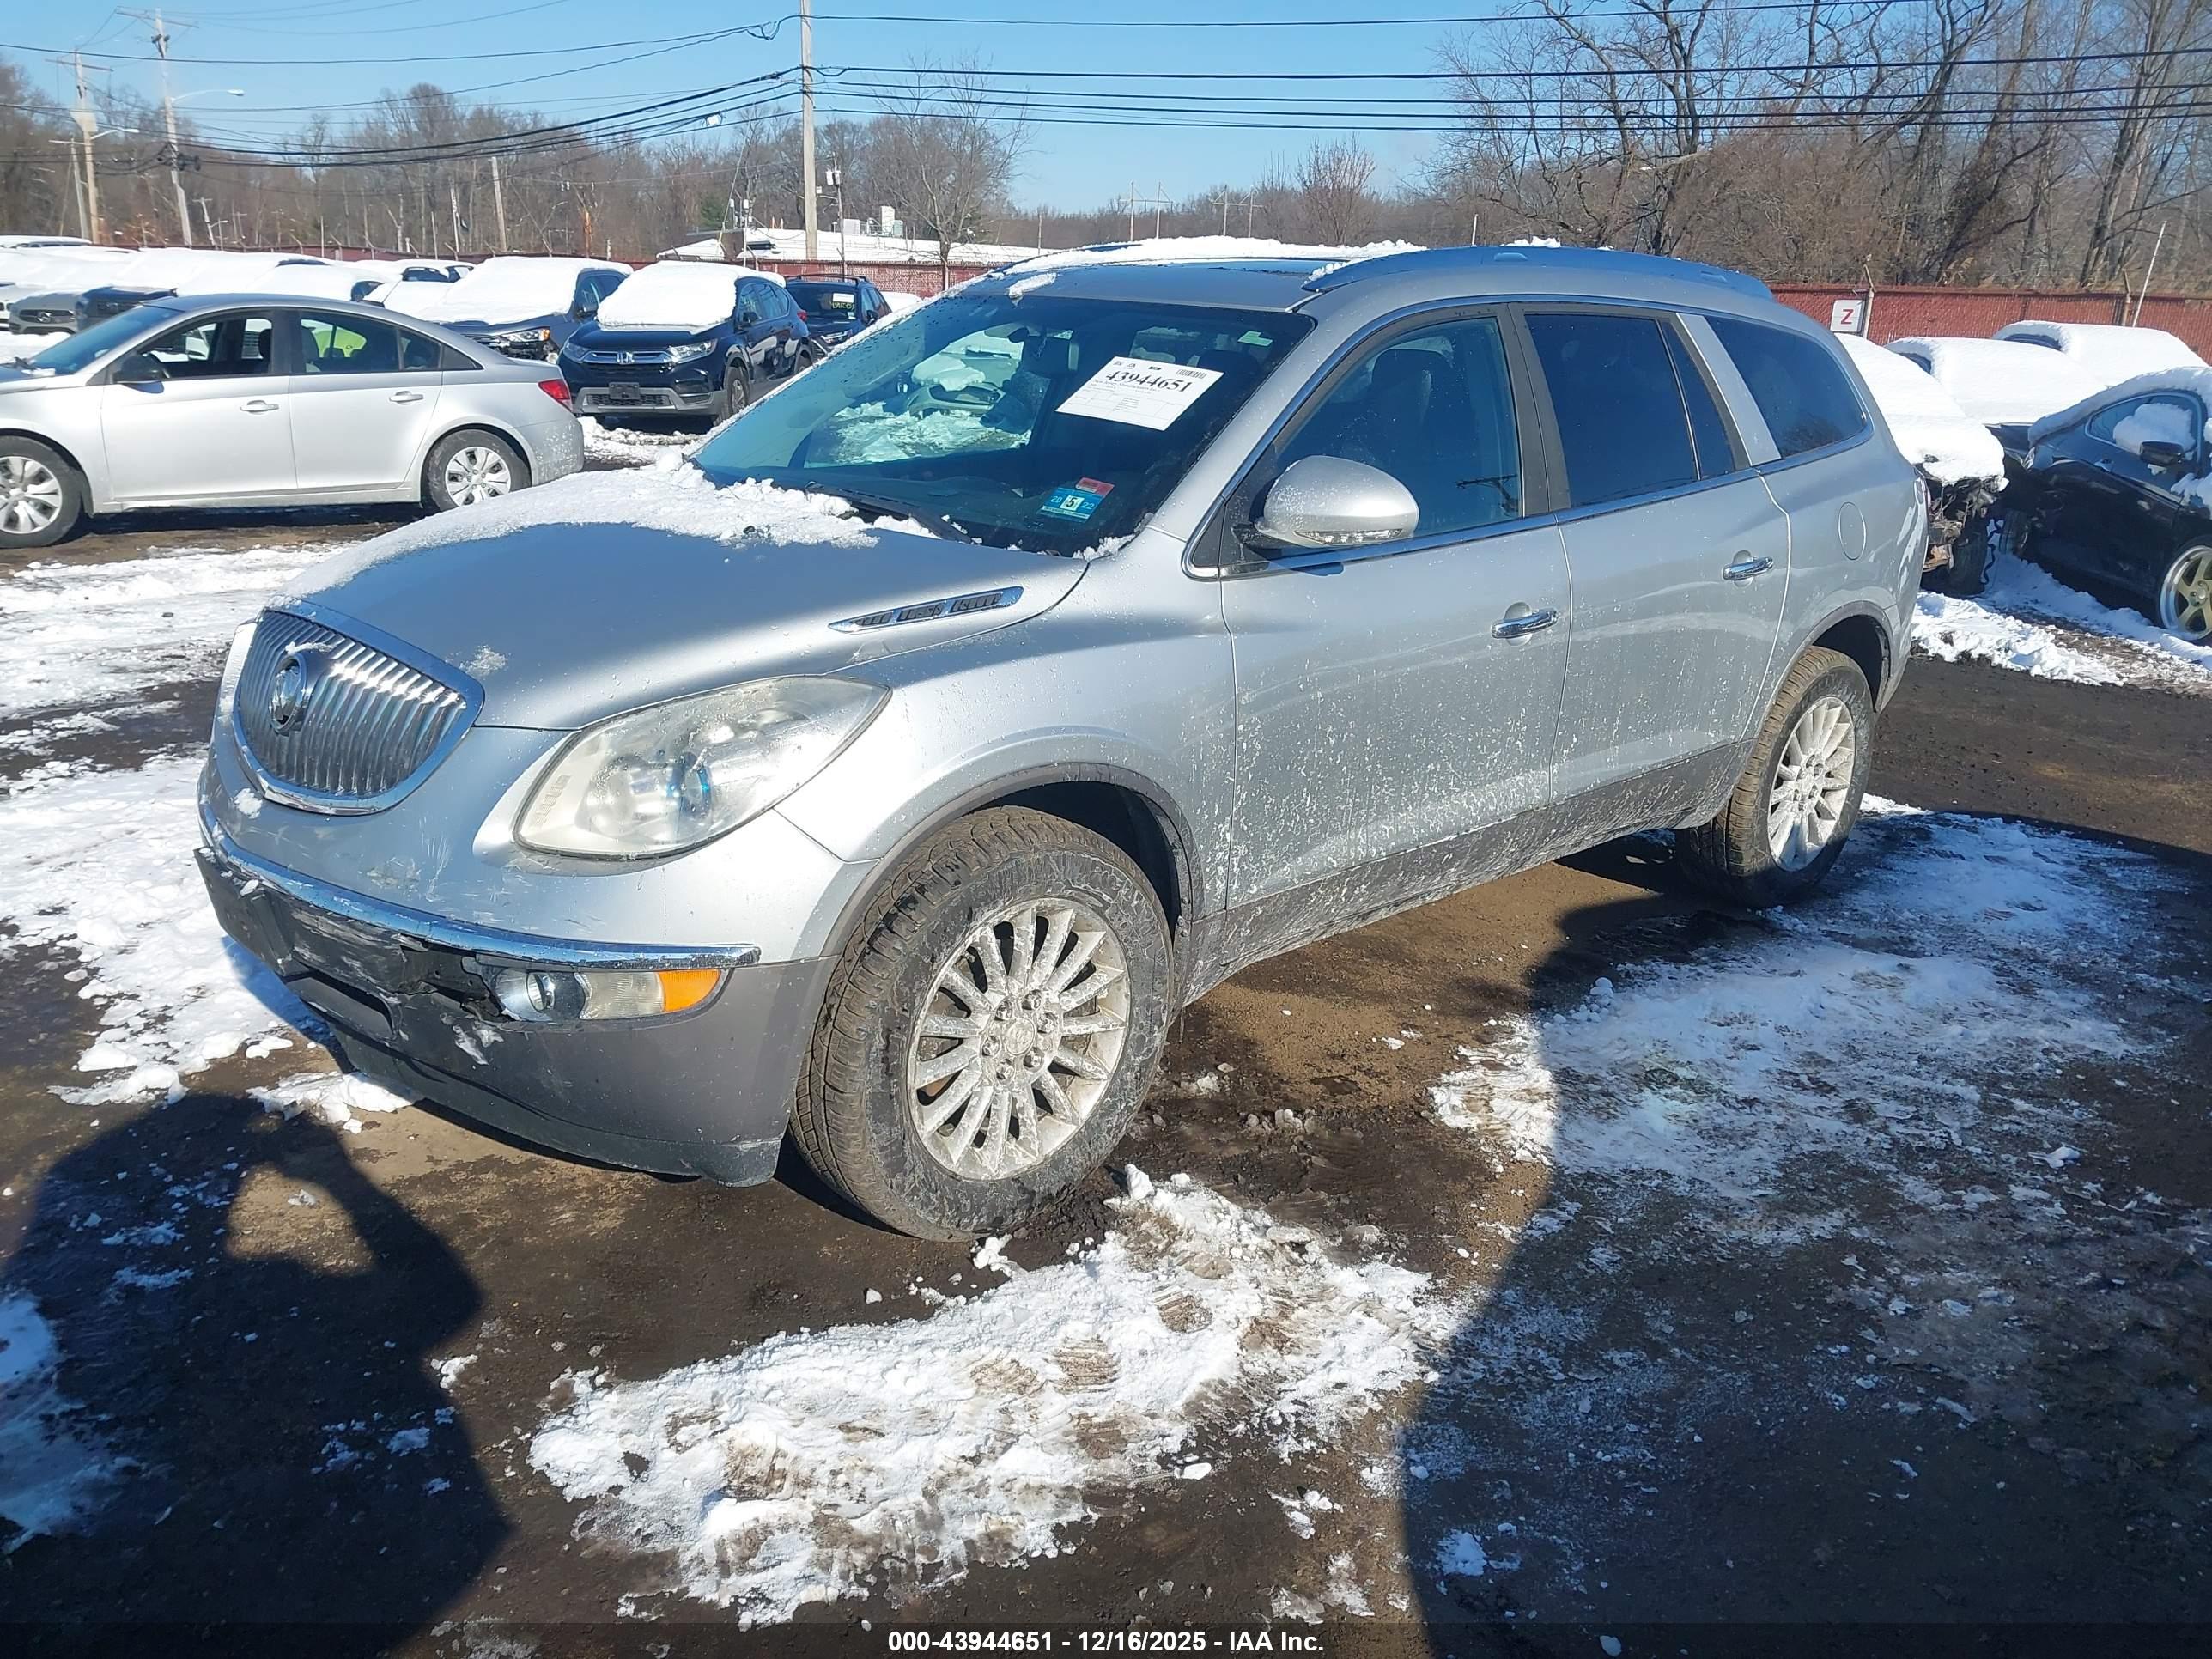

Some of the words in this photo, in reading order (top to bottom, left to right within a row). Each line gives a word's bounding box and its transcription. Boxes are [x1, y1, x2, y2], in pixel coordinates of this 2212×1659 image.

[1841, 309, 1854, 325] Z
[1106, 370, 1193, 392] 43944651
[1066, 497, 1077, 507] 5
